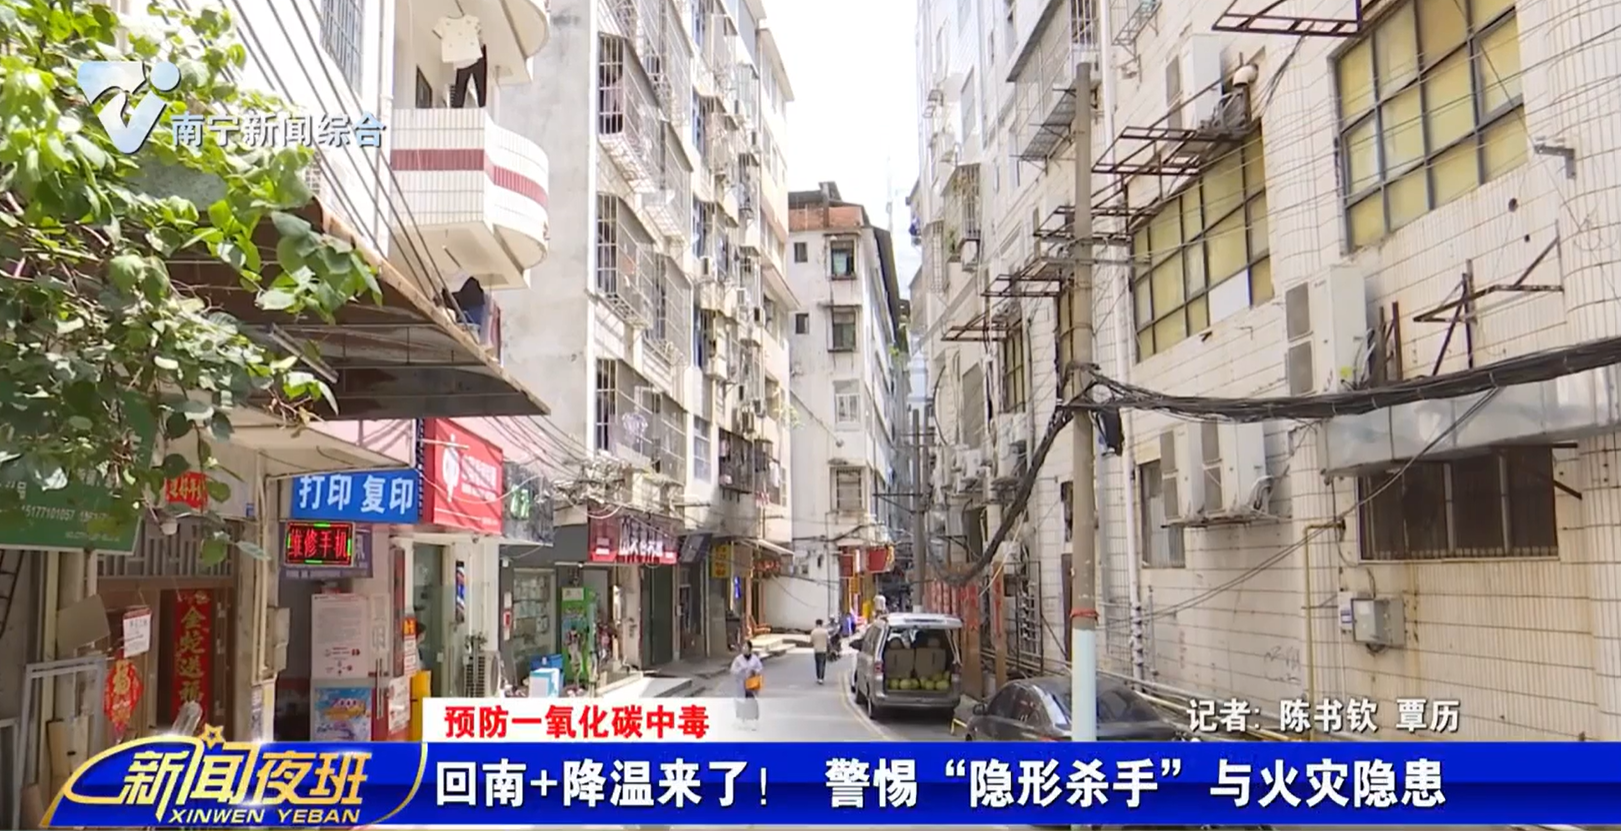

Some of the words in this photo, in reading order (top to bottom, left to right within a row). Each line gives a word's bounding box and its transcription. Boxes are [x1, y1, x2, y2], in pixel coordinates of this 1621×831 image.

[299, 474, 352, 511] 打印
[361, 474, 414, 515] 复印
[288, 527, 348, 559] 维修手机
